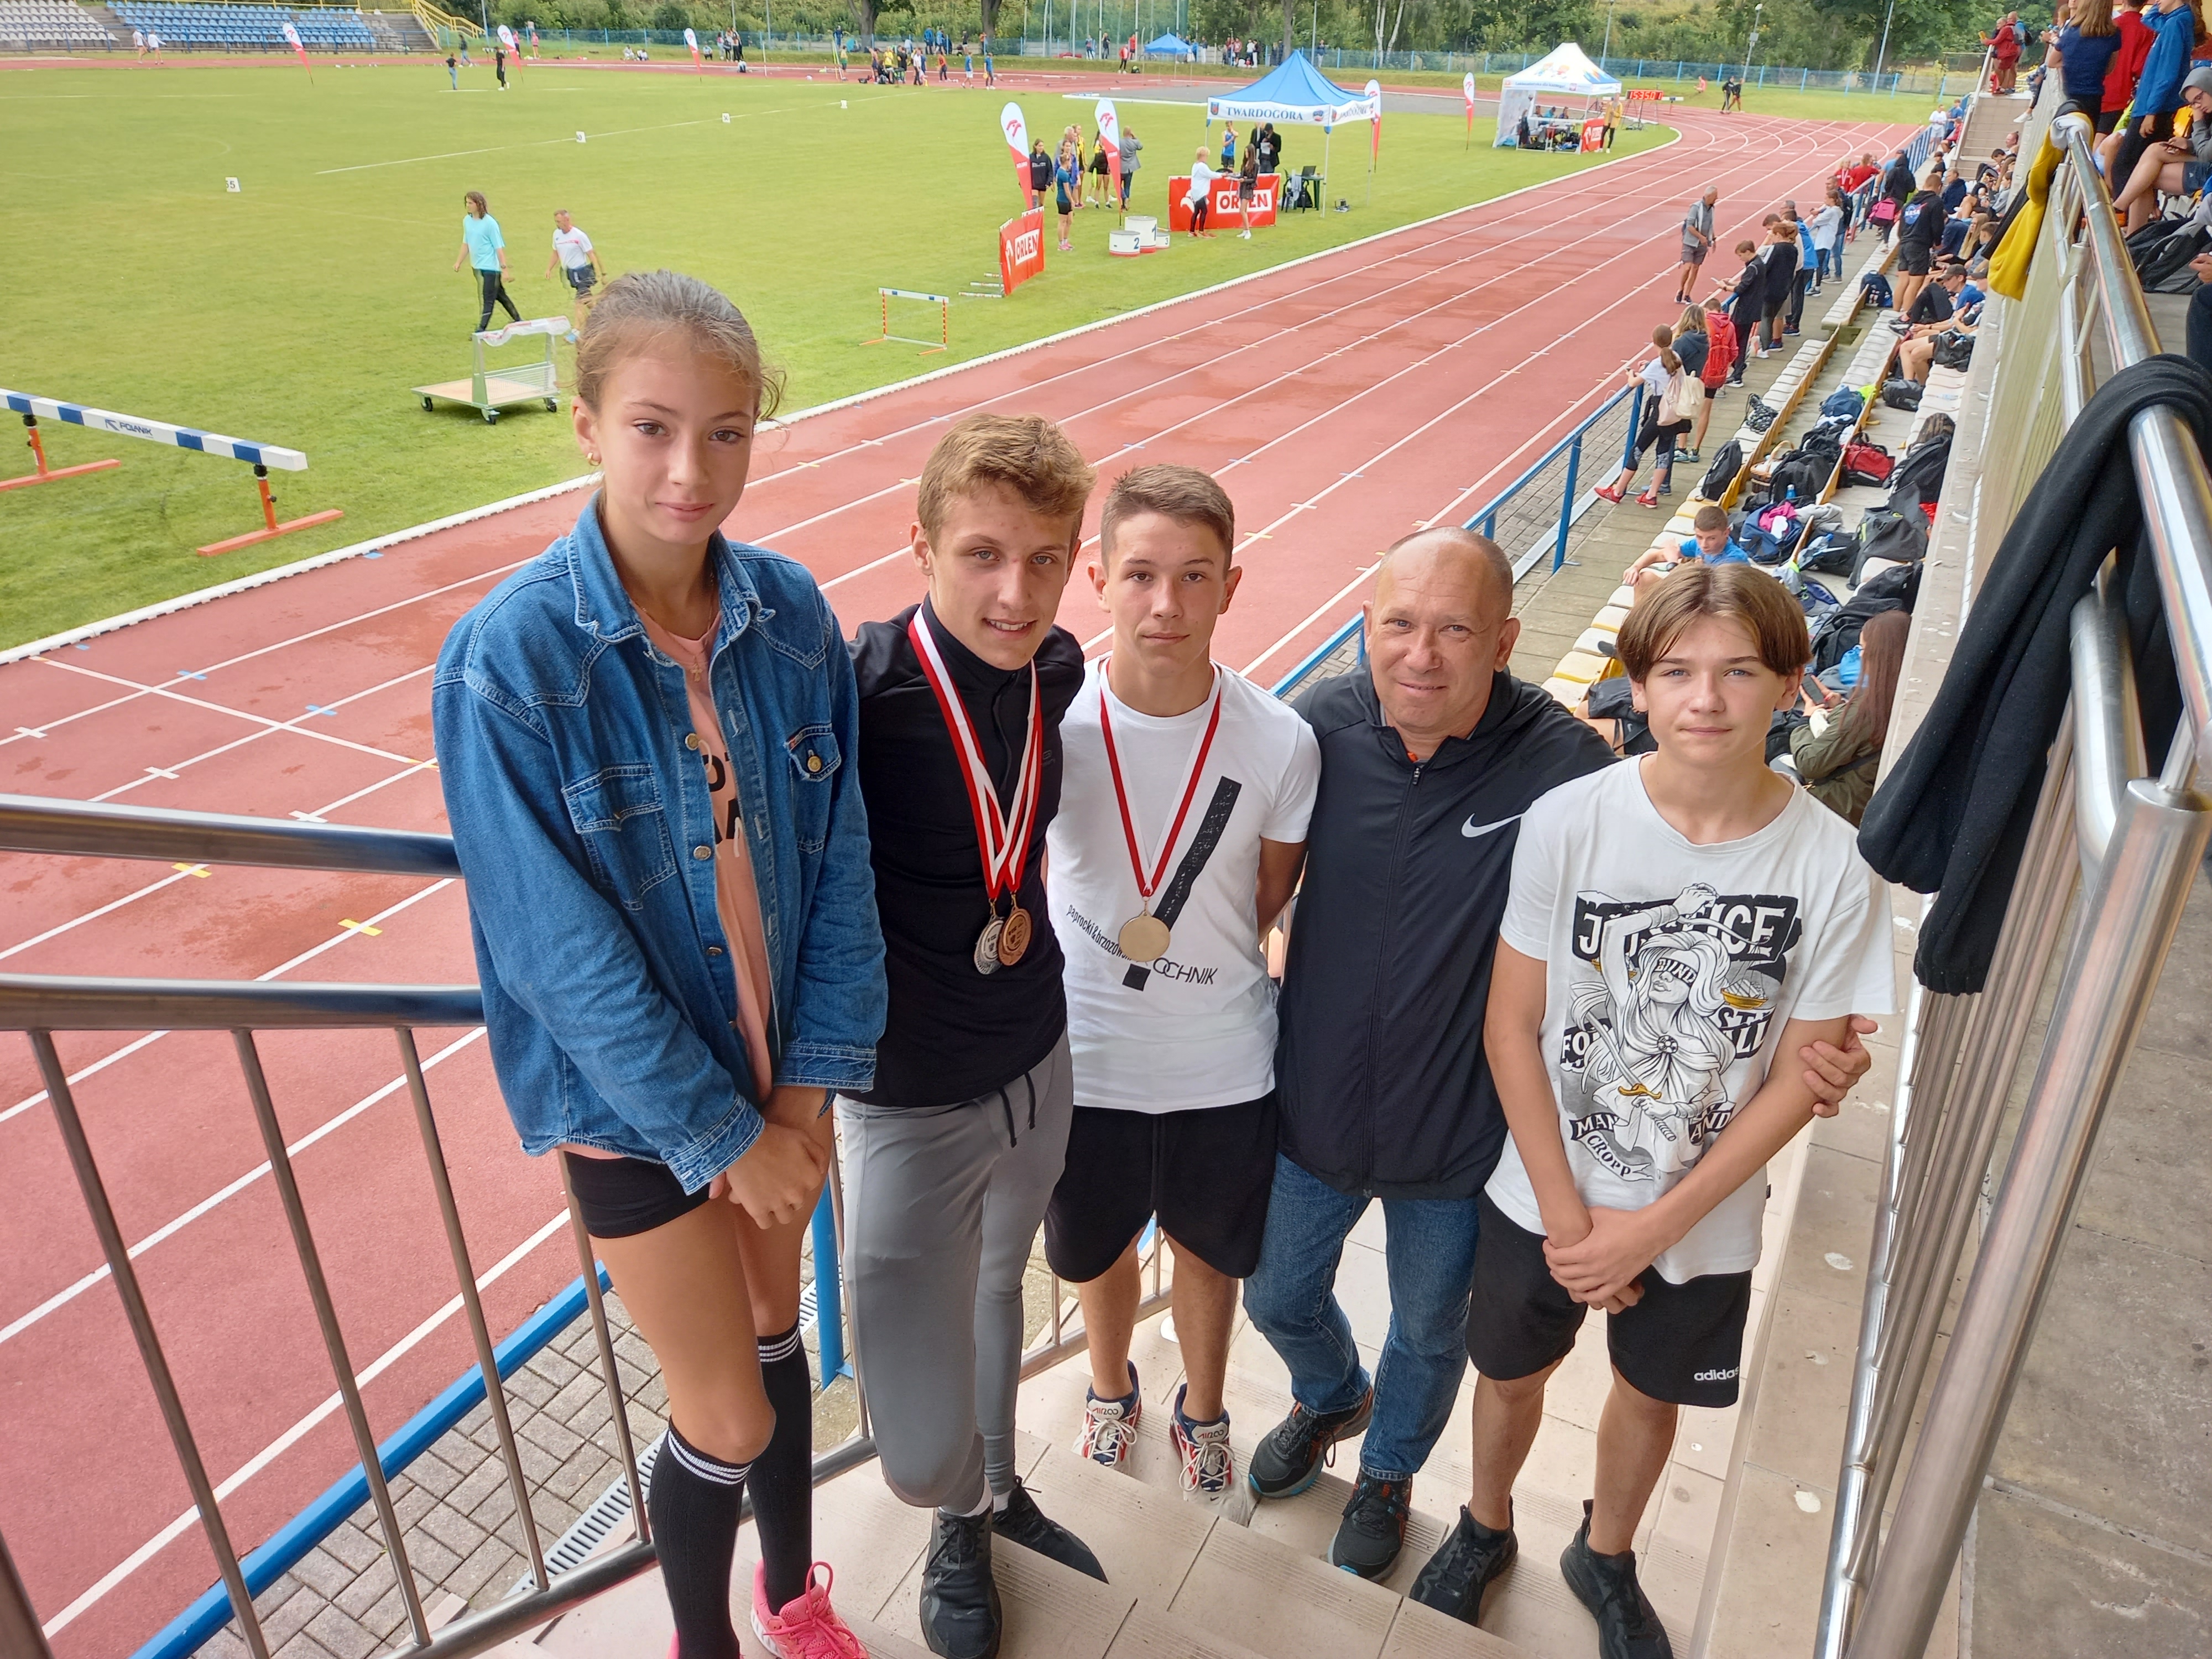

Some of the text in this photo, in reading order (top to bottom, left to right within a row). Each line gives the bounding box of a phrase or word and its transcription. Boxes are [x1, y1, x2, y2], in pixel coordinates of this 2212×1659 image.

[1226, 106, 1303, 121] TWARDOGÓRA
[1219, 193, 1268, 210] OREN
[1133, 237, 1140, 249] 2
[1151, 223, 1157, 241] 1
[1016, 233, 1038, 260] ORLEN
[119, 421, 153, 436] POLANIK
[1066, 904, 1133, 962] paprocki&brzozow
[1578, 904, 1787, 957] JICE
[1153, 957, 1218, 985] OCHNIK
[1587, 1135, 1631, 1177] CROPP
